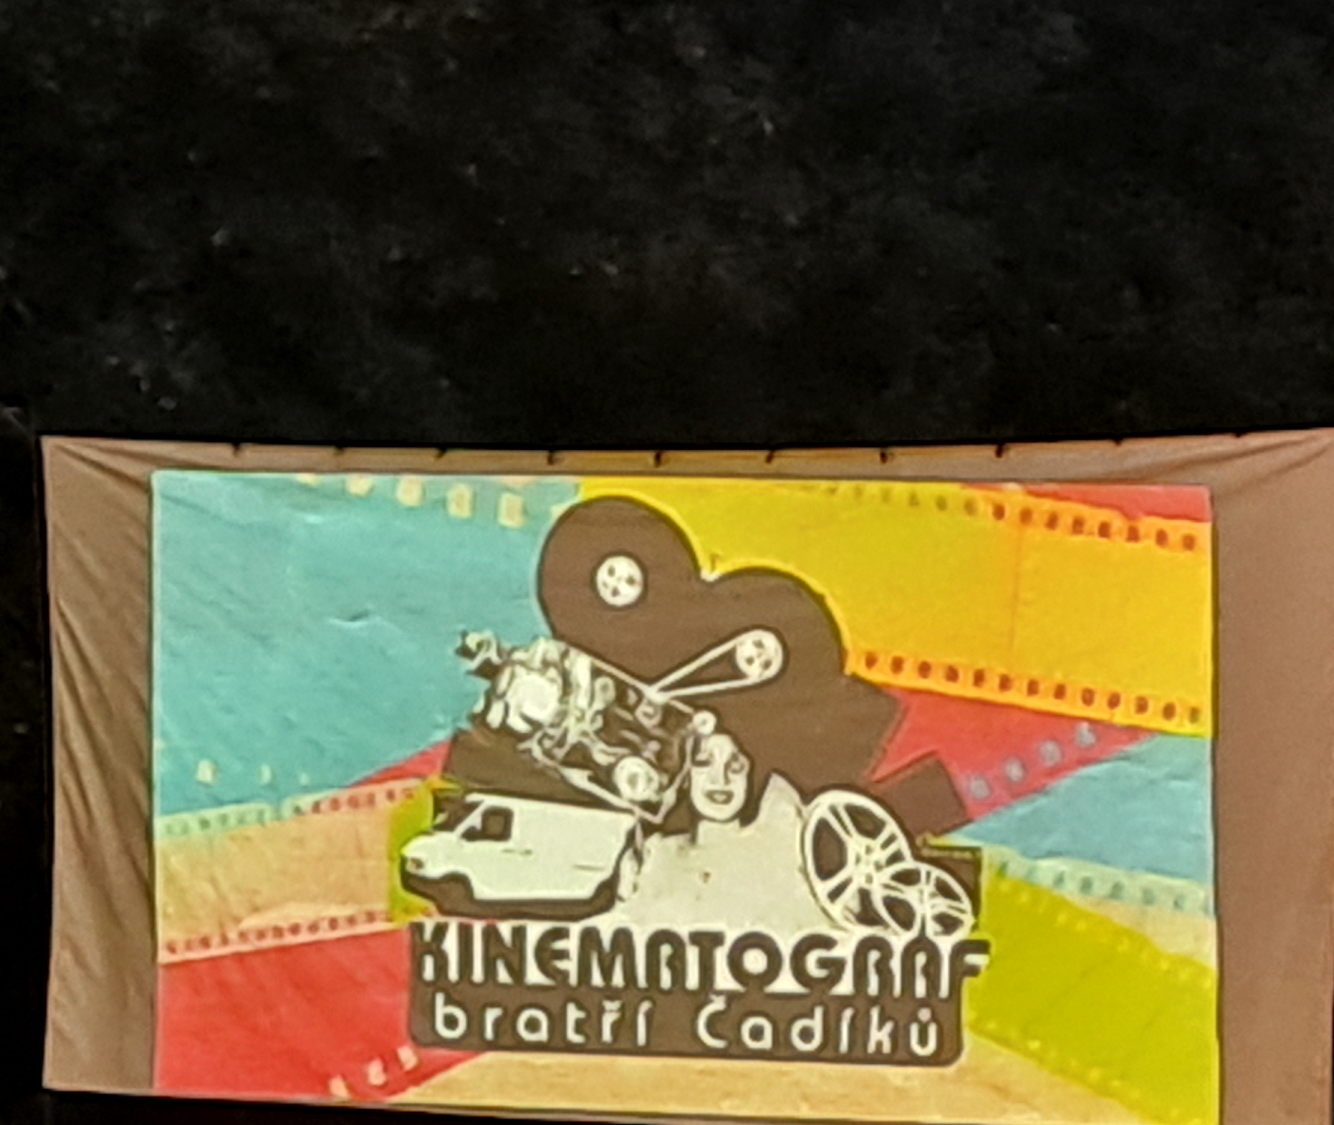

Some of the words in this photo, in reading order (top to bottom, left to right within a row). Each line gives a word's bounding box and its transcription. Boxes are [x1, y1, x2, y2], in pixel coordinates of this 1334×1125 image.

[411, 922, 991, 999] KINEMATOGRAF
[435, 993, 654, 1046] bratří
[697, 994, 939, 1057] Čadíků
